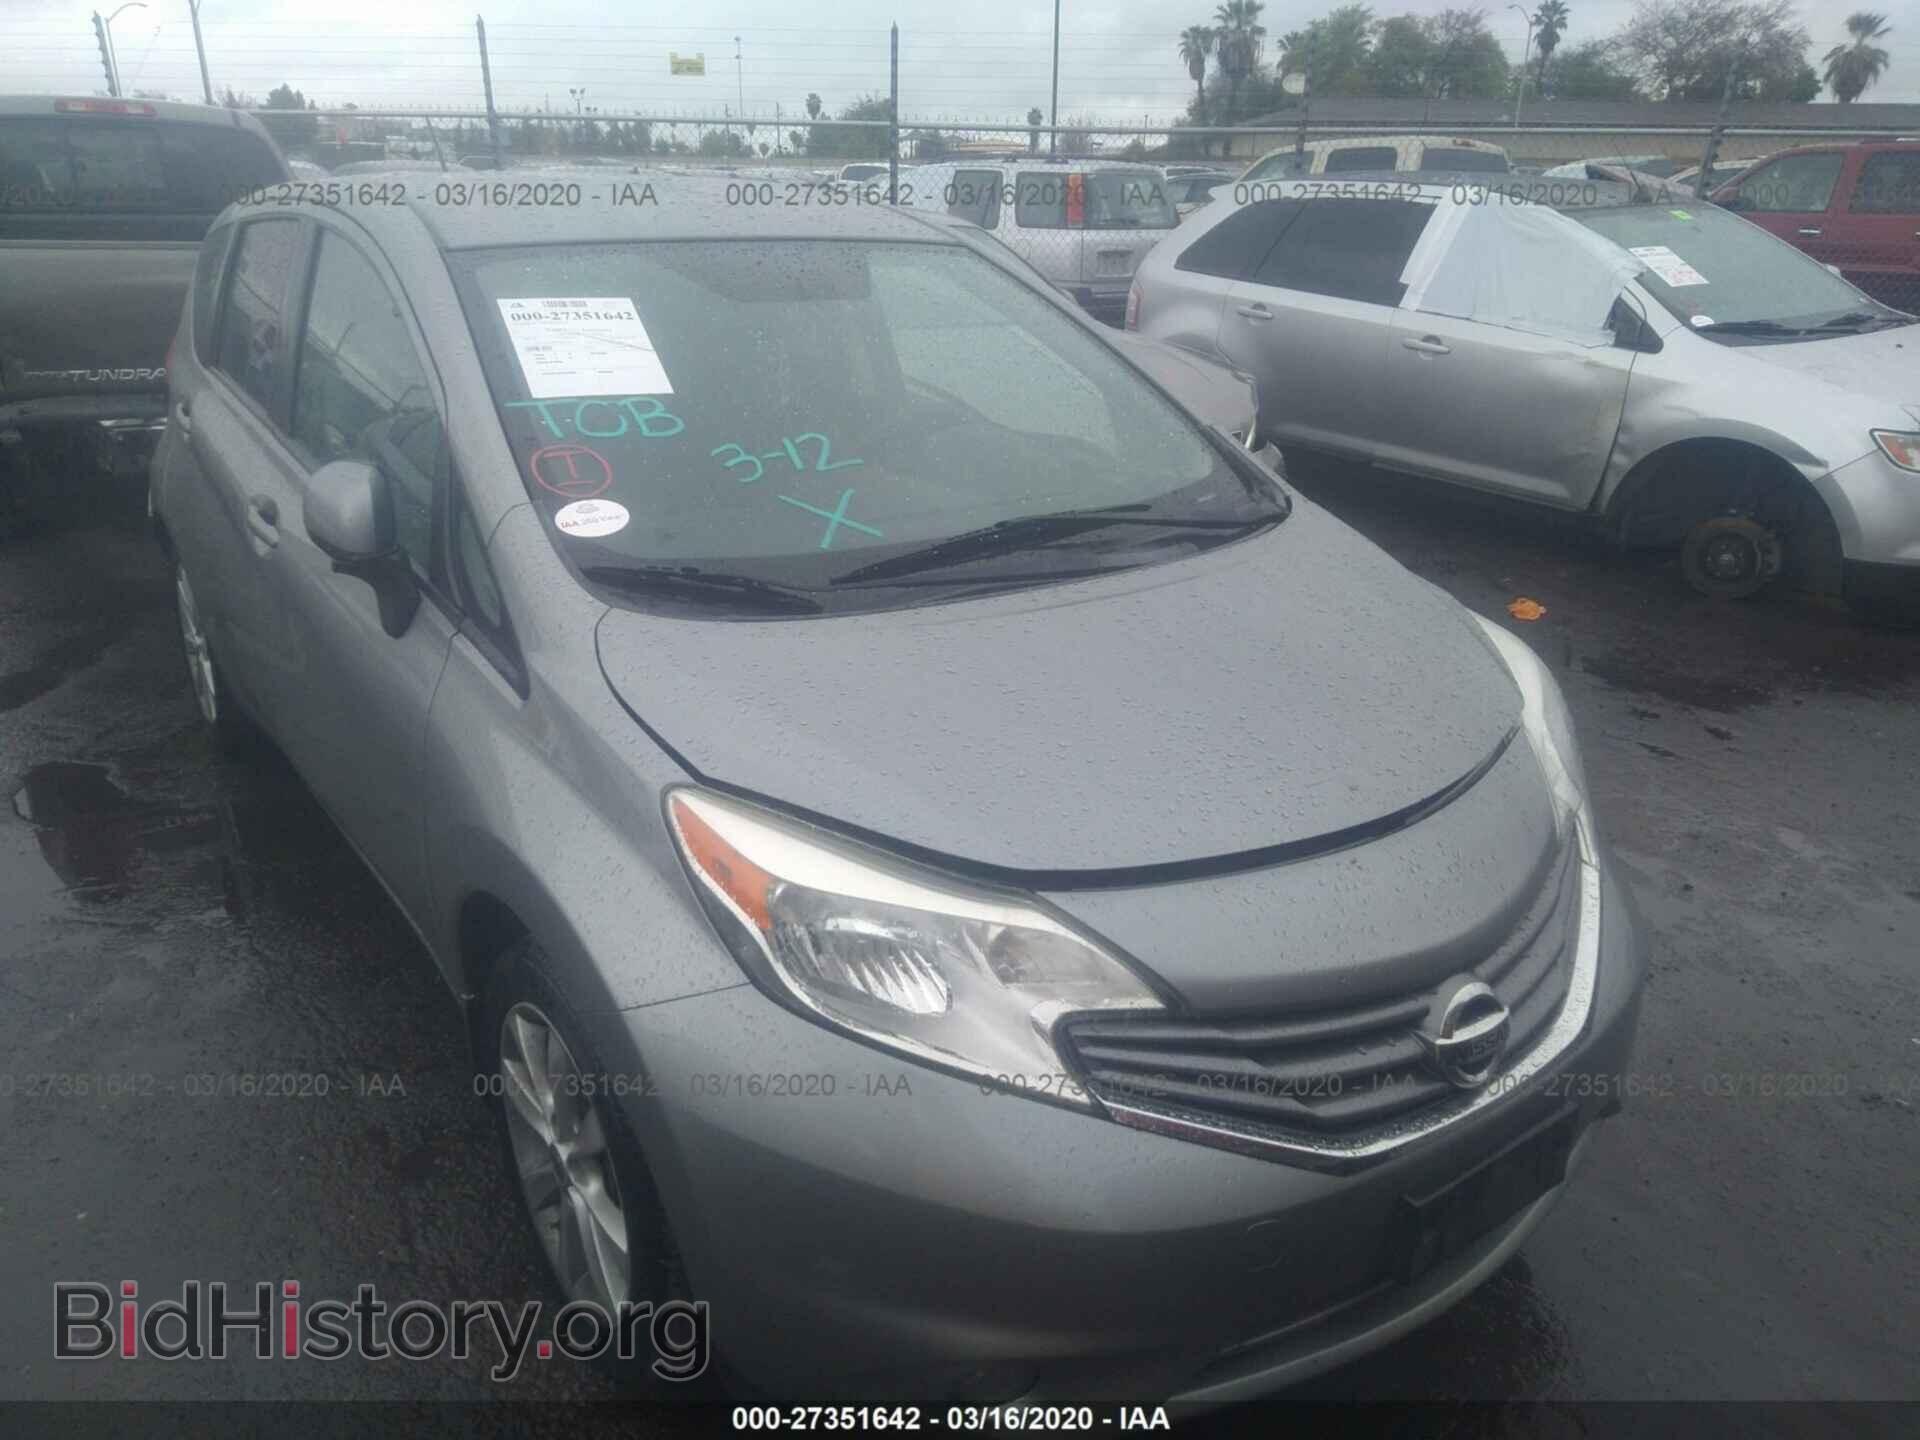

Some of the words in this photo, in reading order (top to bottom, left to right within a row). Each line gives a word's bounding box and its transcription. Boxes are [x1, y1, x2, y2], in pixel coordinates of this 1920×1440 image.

[510, 311, 635, 321] 000-27351642
[68, 367, 167, 381] TUNDRA
[711, 432, 864, 483] 3-12
